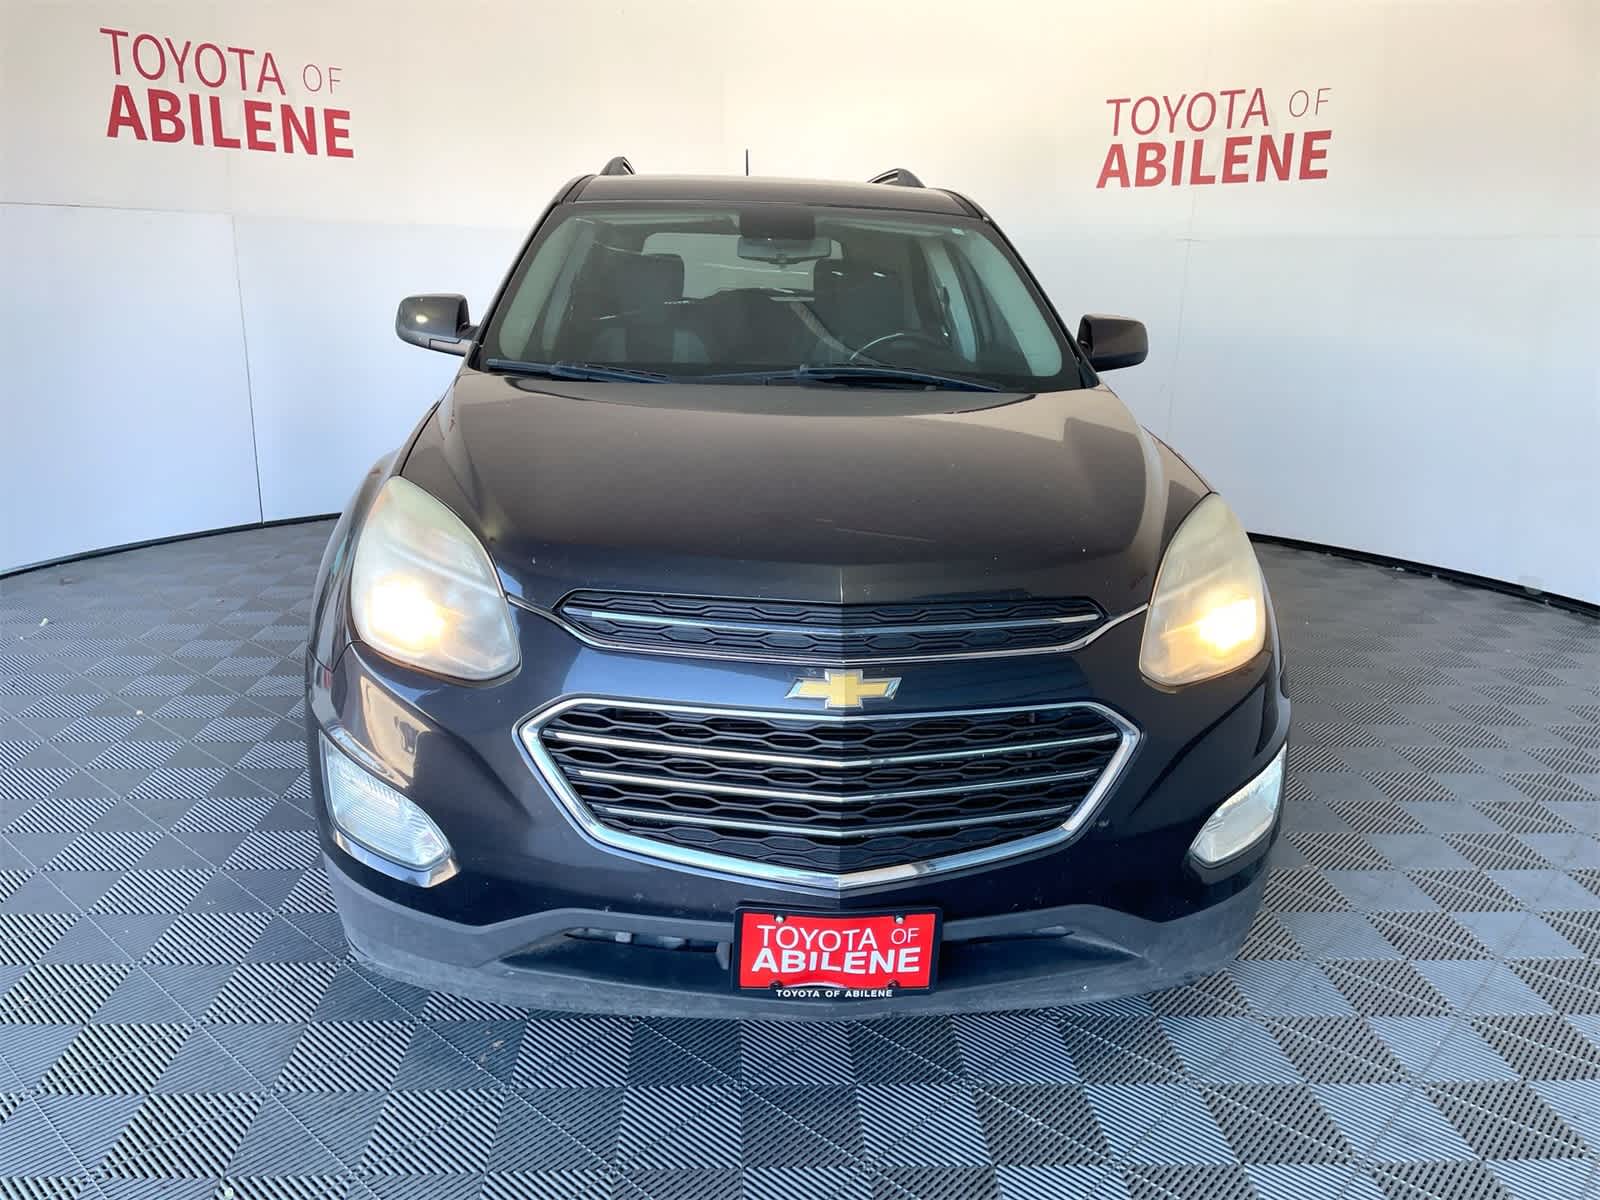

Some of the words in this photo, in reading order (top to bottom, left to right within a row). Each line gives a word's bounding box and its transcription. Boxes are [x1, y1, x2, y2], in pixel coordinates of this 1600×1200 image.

[100, 28, 286, 95] TOYOTA
[303, 64, 342, 93] OF
[107, 84, 354, 158] ABILENE
[1106, 88, 1269, 136] TOYOTA
[1289, 88, 1332, 117] OF
[1096, 130, 1332, 188] ABILENE
[752, 947, 921, 974] ABILENE
[757, 925, 878, 951] TOYOTA
[891, 928, 919, 944] OF
[776, 989, 820, 998] TOYOTA
[825, 989, 840, 998] OF
[845, 989, 893, 998] ABILENE
